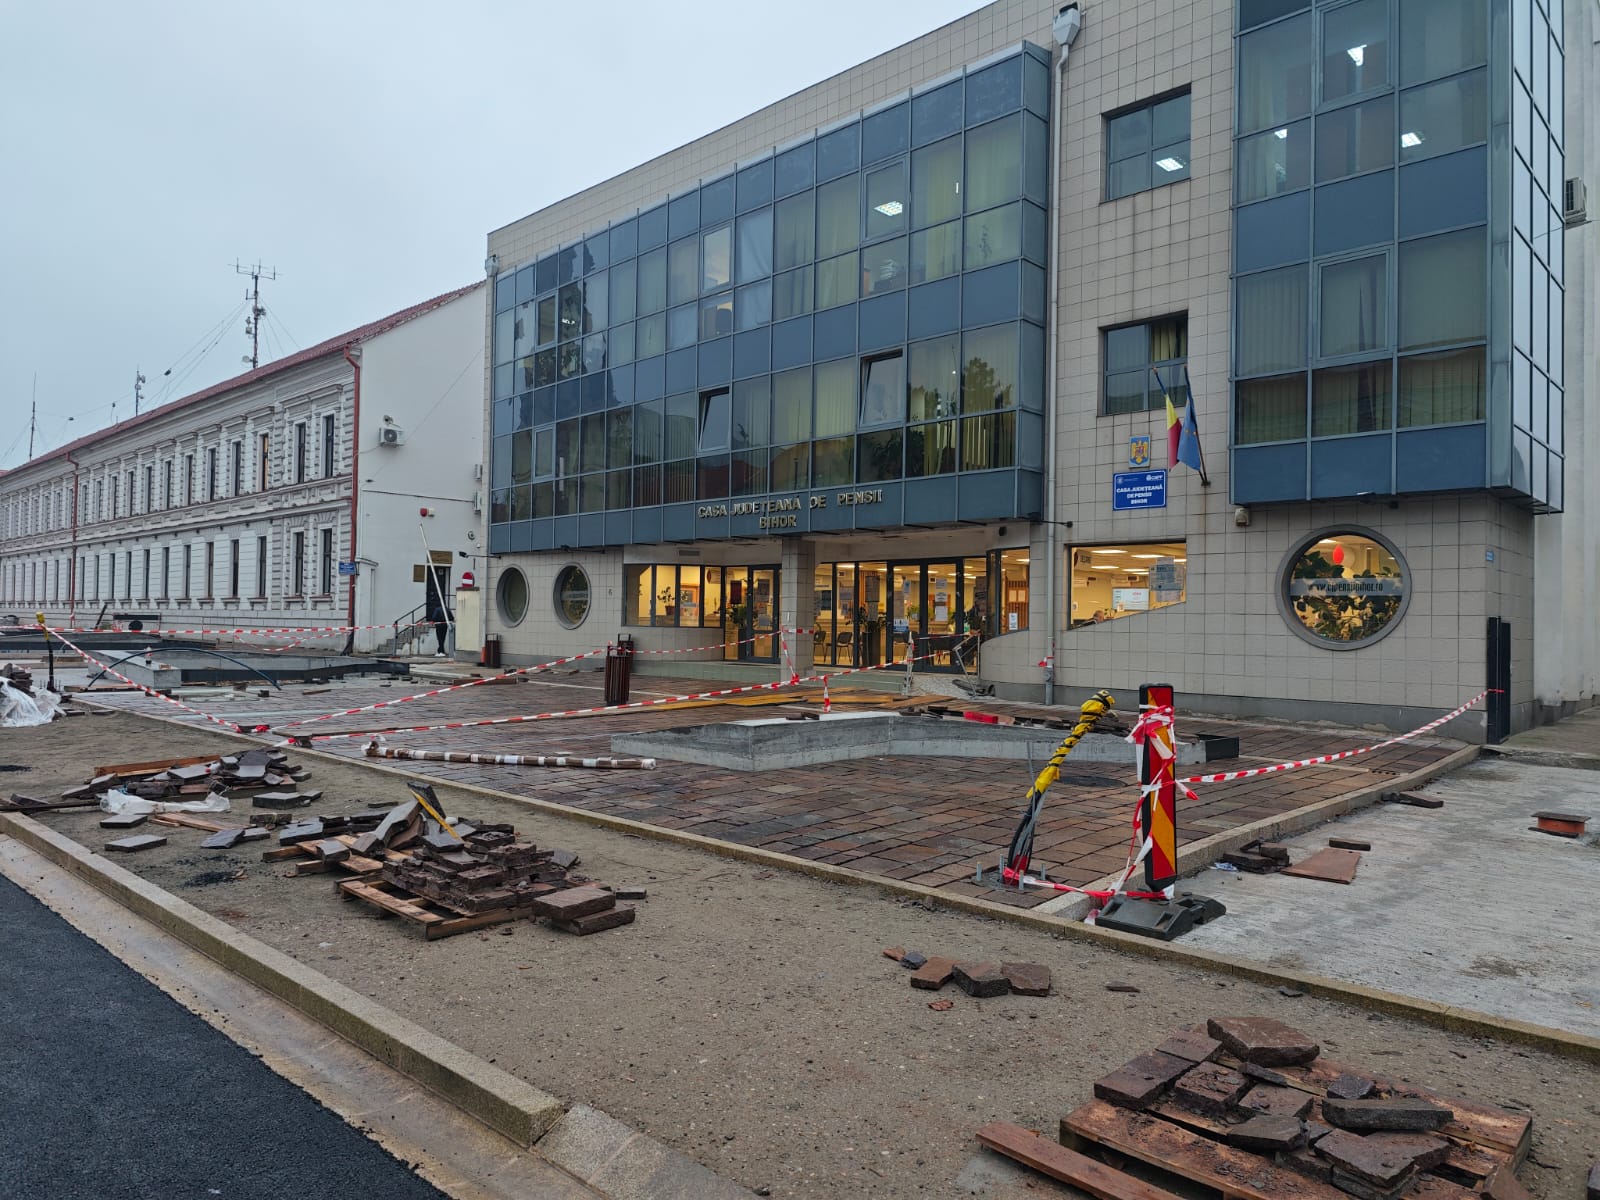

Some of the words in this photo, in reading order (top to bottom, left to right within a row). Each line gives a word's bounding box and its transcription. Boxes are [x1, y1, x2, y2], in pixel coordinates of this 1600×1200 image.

[698, 504, 727, 519] CASA
[810, 495, 827, 509] DE
[837, 489, 883, 506] PENSII
[759, 514, 797, 529] BIHOR
